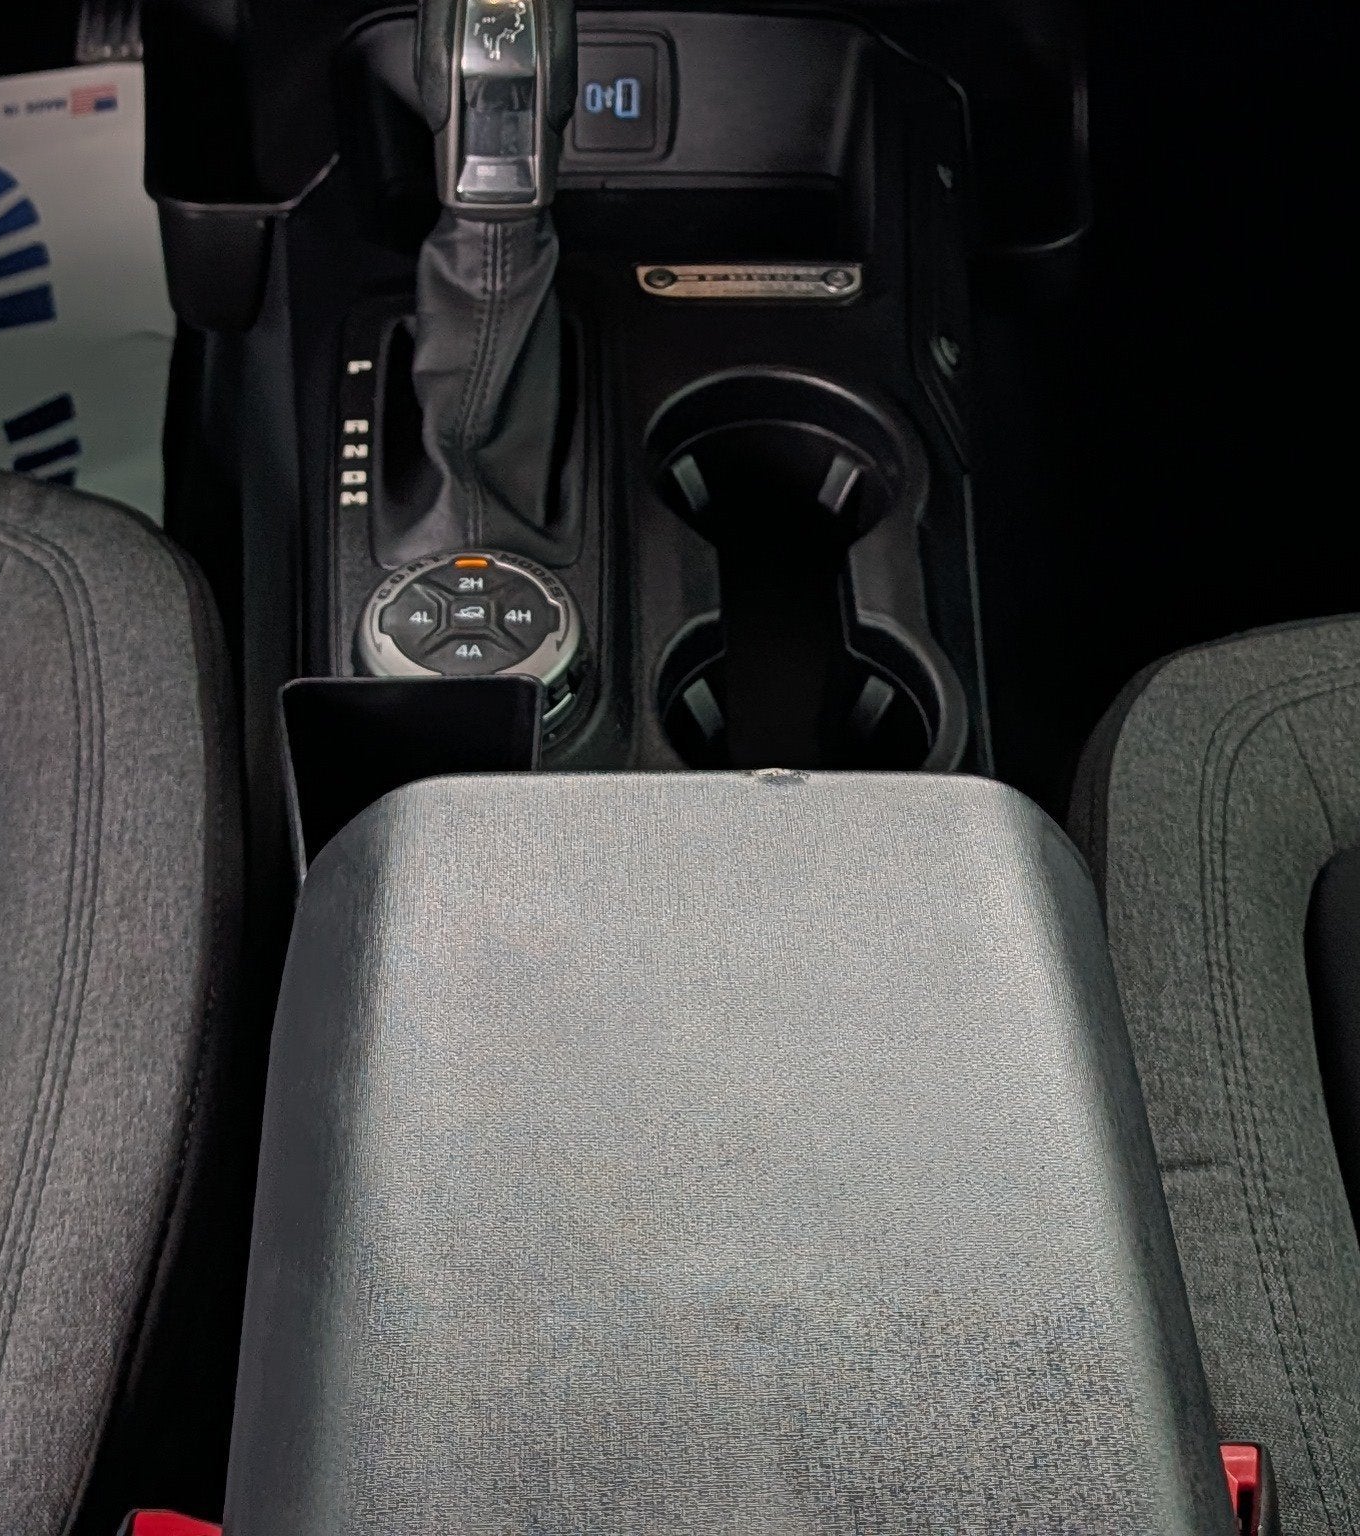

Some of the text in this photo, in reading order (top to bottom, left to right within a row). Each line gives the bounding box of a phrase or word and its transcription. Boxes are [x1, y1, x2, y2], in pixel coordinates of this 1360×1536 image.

[347, 360, 373, 374] P
[343, 419, 369, 434] R
[342, 443, 369, 459] N
[341, 470, 367, 485] D
[340, 490, 368, 506] M
[458, 577, 484, 590] 2H
[408, 610, 434, 623] 4L
[504, 609, 532, 624] 4H
[455, 644, 483, 658] 4A
